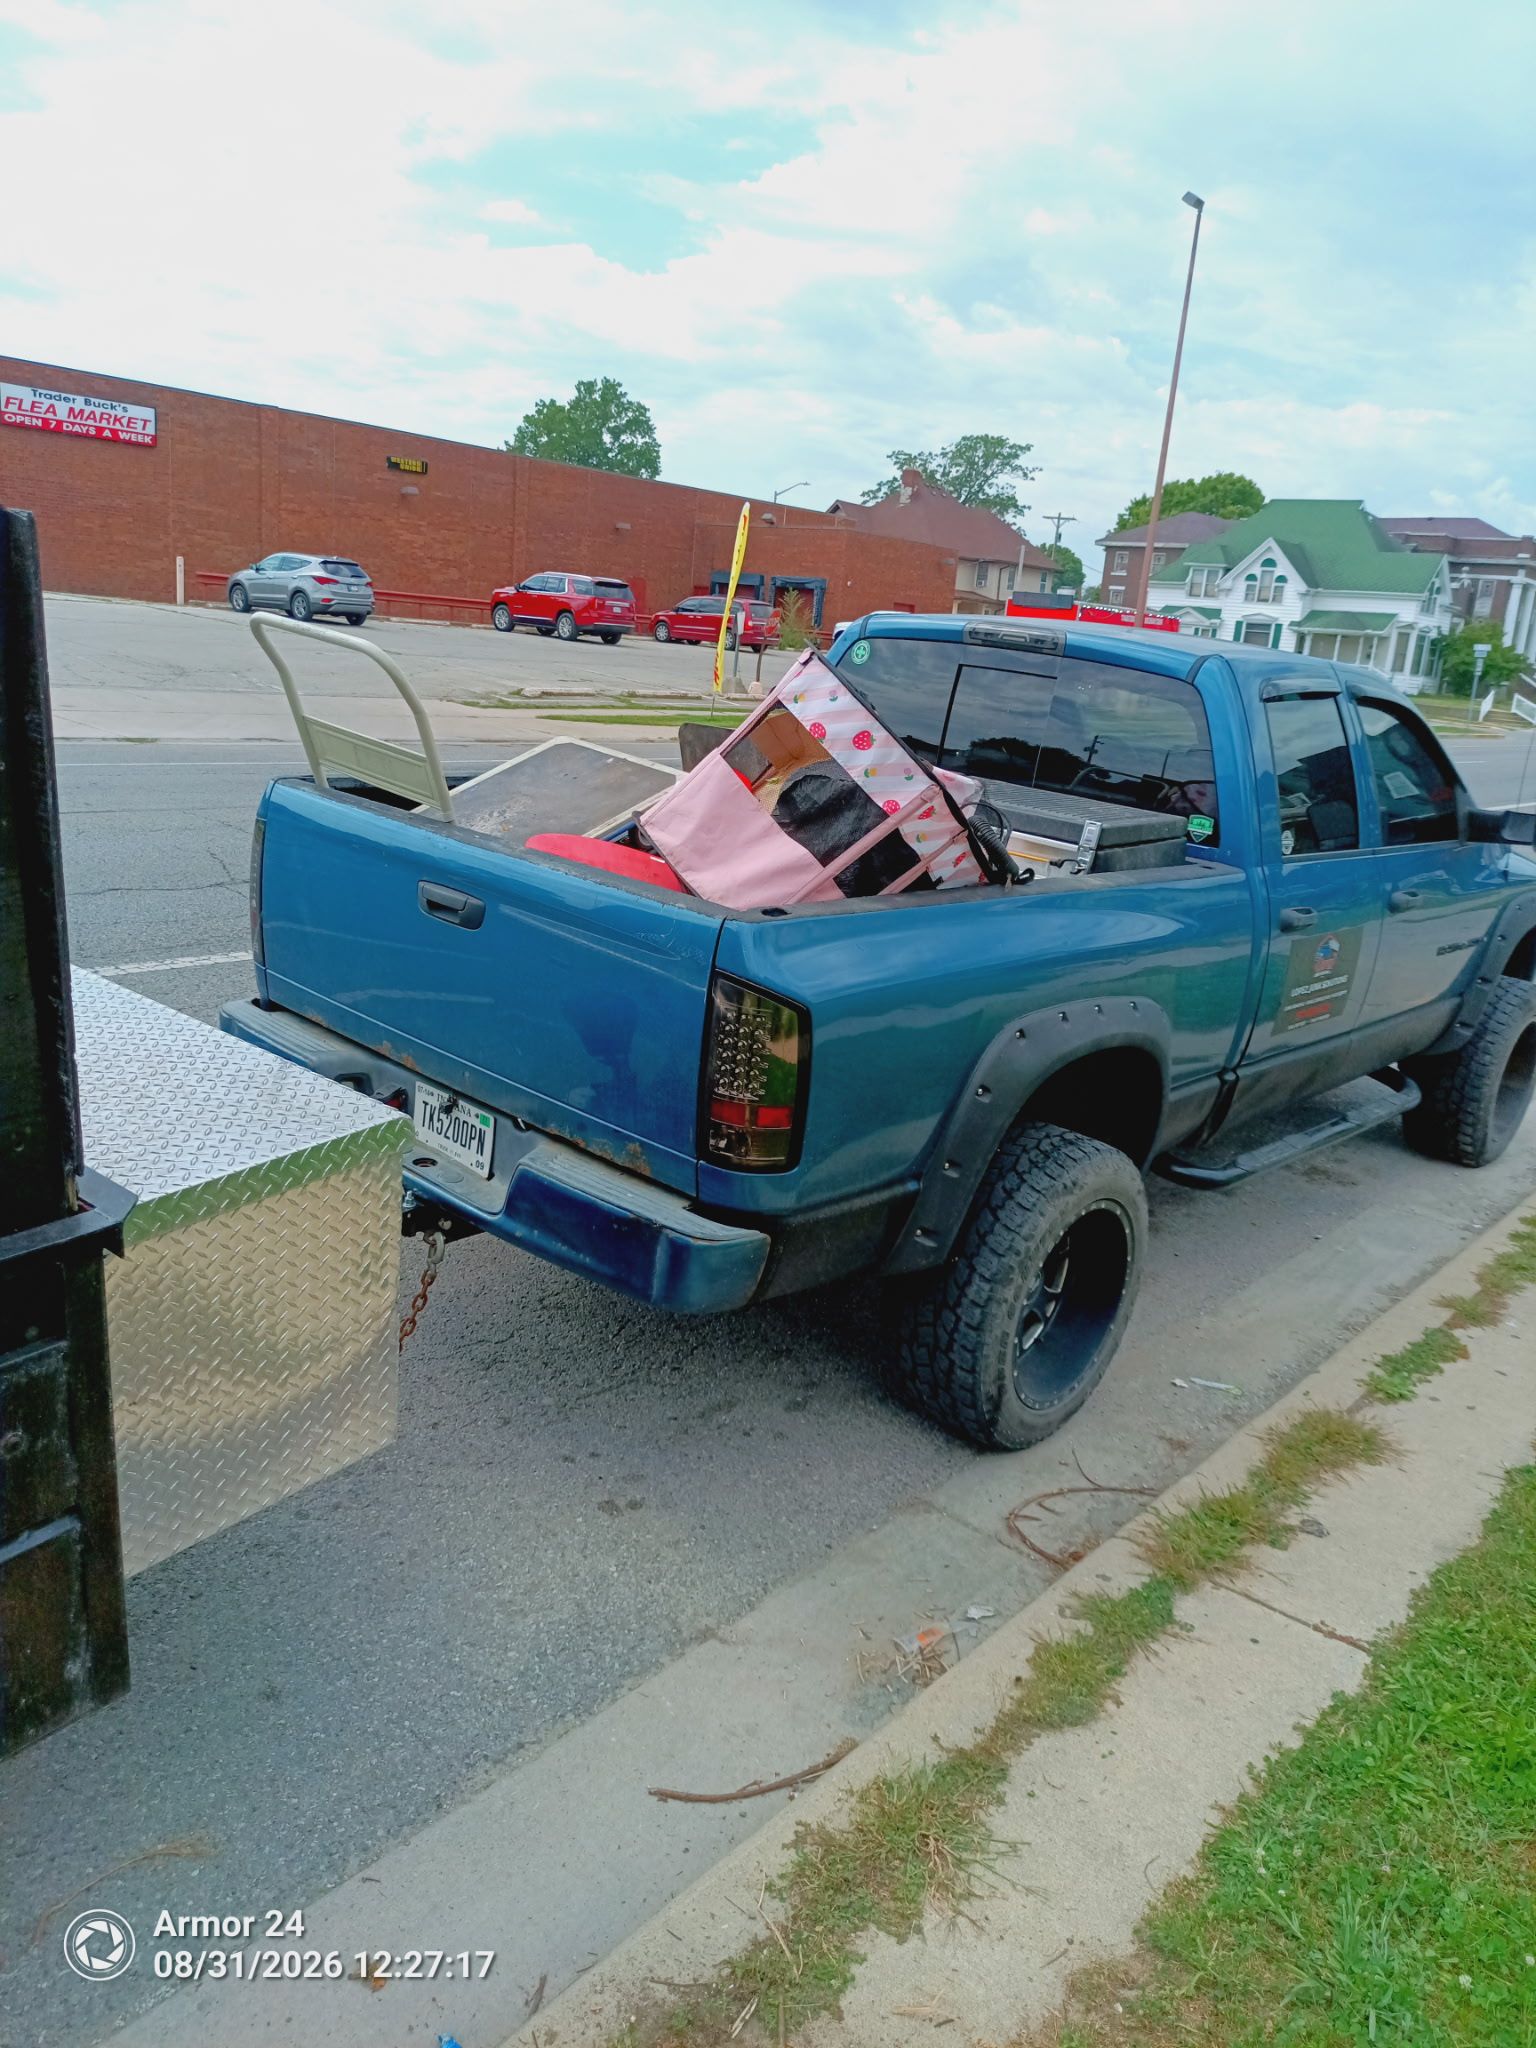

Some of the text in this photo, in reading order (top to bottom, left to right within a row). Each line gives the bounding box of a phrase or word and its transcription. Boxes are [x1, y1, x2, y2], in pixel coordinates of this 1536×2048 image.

[4, 396, 152, 432] FLEA MARKET
[31, 389, 129, 413] Trader Buck's
[4, 413, 152, 444] OPEN 7 DAYS A WEEK
[475, 1159, 485, 1171] 09
